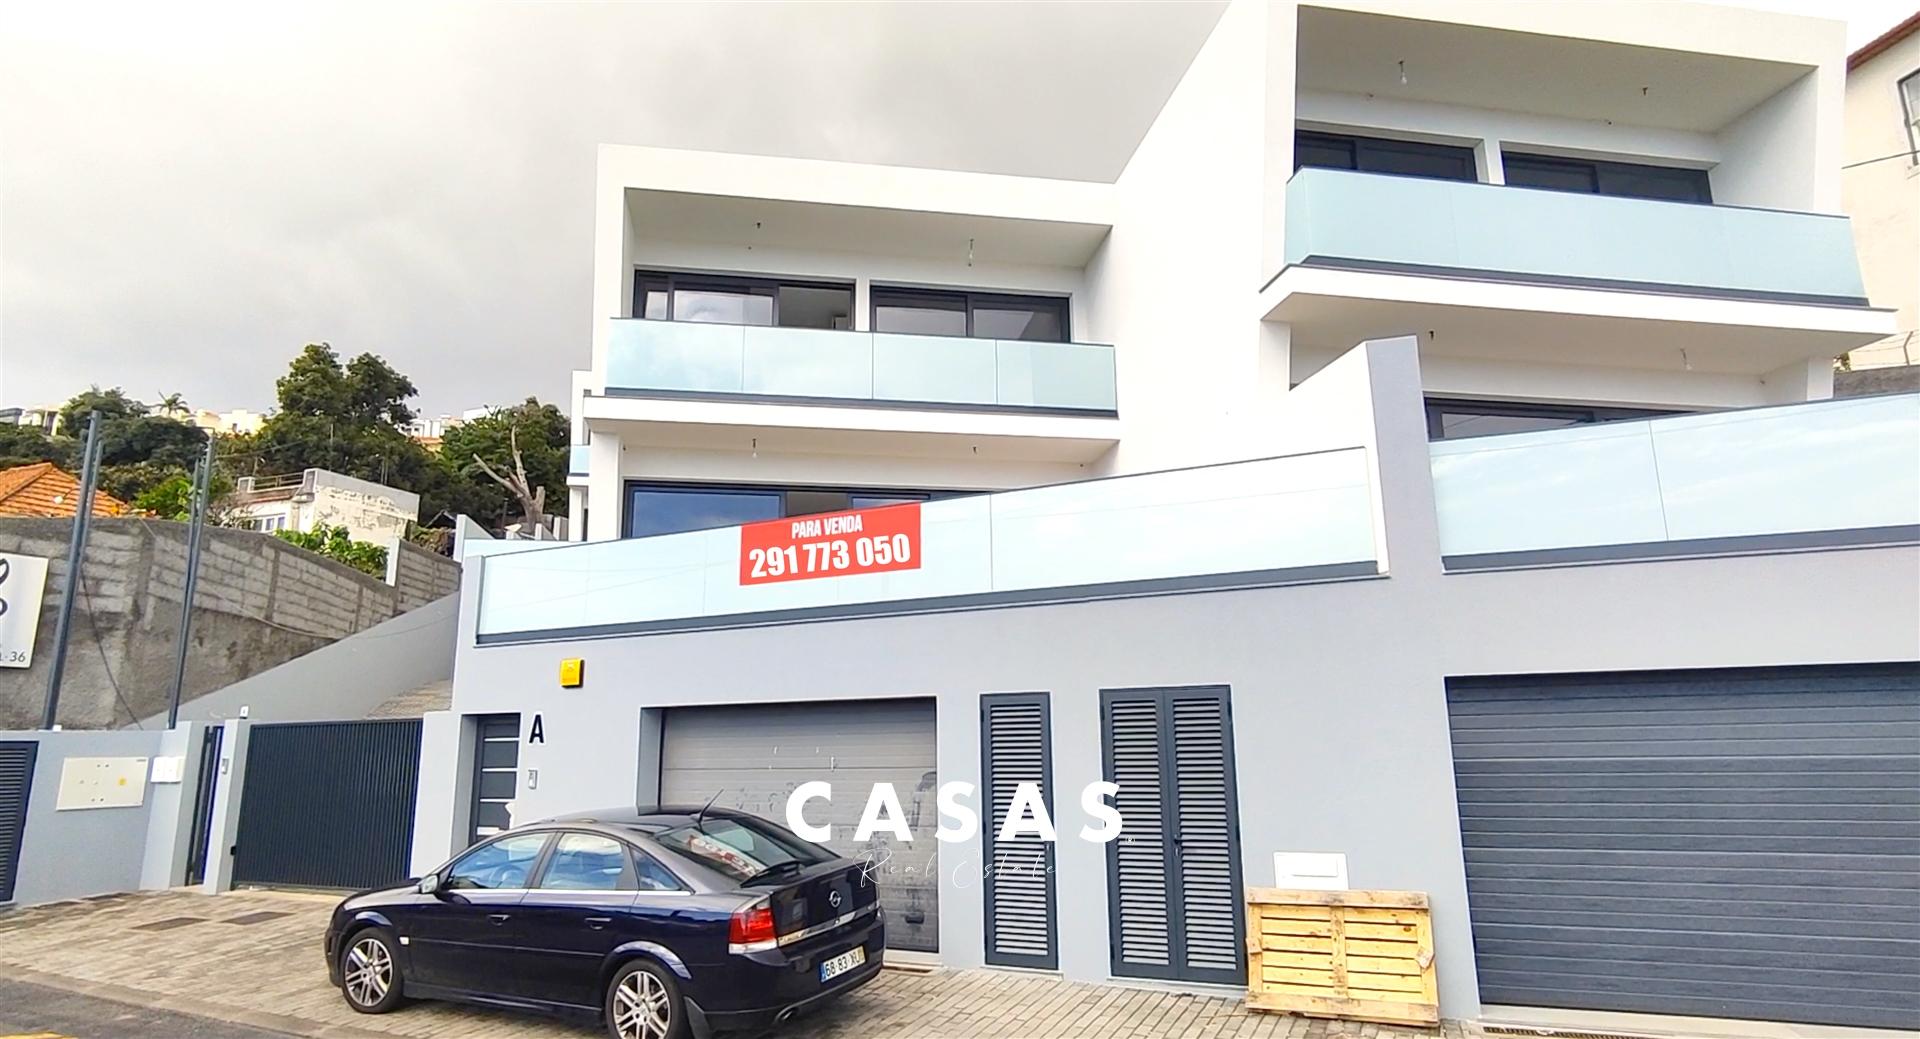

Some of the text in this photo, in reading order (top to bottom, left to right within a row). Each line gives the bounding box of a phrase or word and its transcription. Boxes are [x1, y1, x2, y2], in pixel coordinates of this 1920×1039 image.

[791, 515, 863, 539] PARA VENDA
[750, 534, 911, 578] 291 773 050
[529, 714, 544, 743] A
